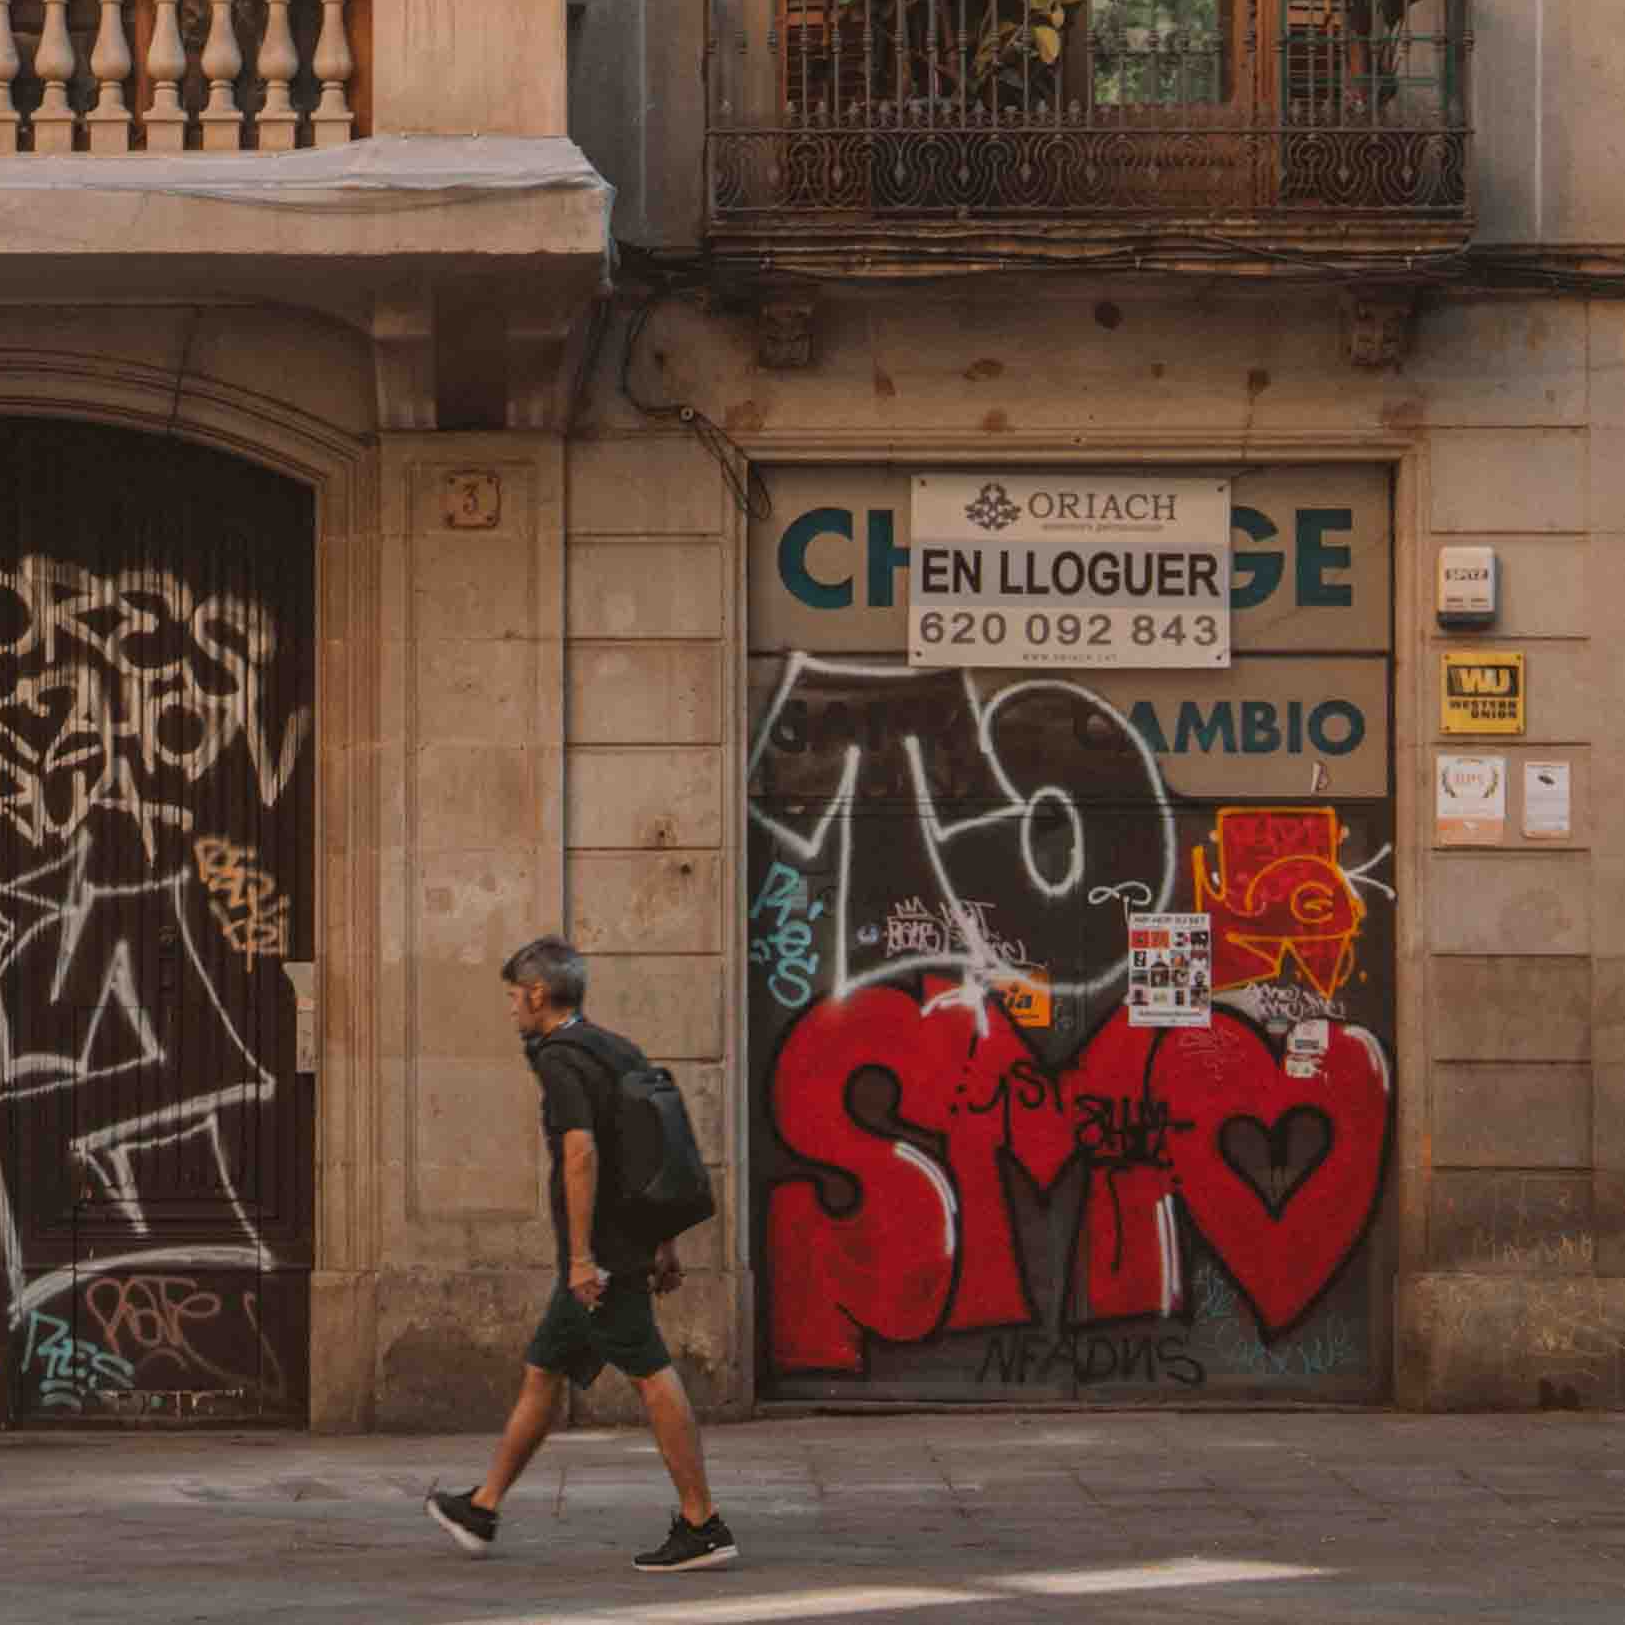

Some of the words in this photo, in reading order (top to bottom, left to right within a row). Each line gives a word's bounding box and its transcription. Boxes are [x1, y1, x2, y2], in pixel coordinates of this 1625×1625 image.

[1027, 491, 1178, 521] ORIACH
[922, 549, 982, 594] EN
[999, 550, 1220, 597] LLOGUER
[920, 612, 1007, 645] 620
[1025, 612, 1112, 646] 092
[1131, 614, 1218, 647] 843
[1449, 700, 1517, 710] WESTERN
[1471, 709, 1517, 719] UNION
